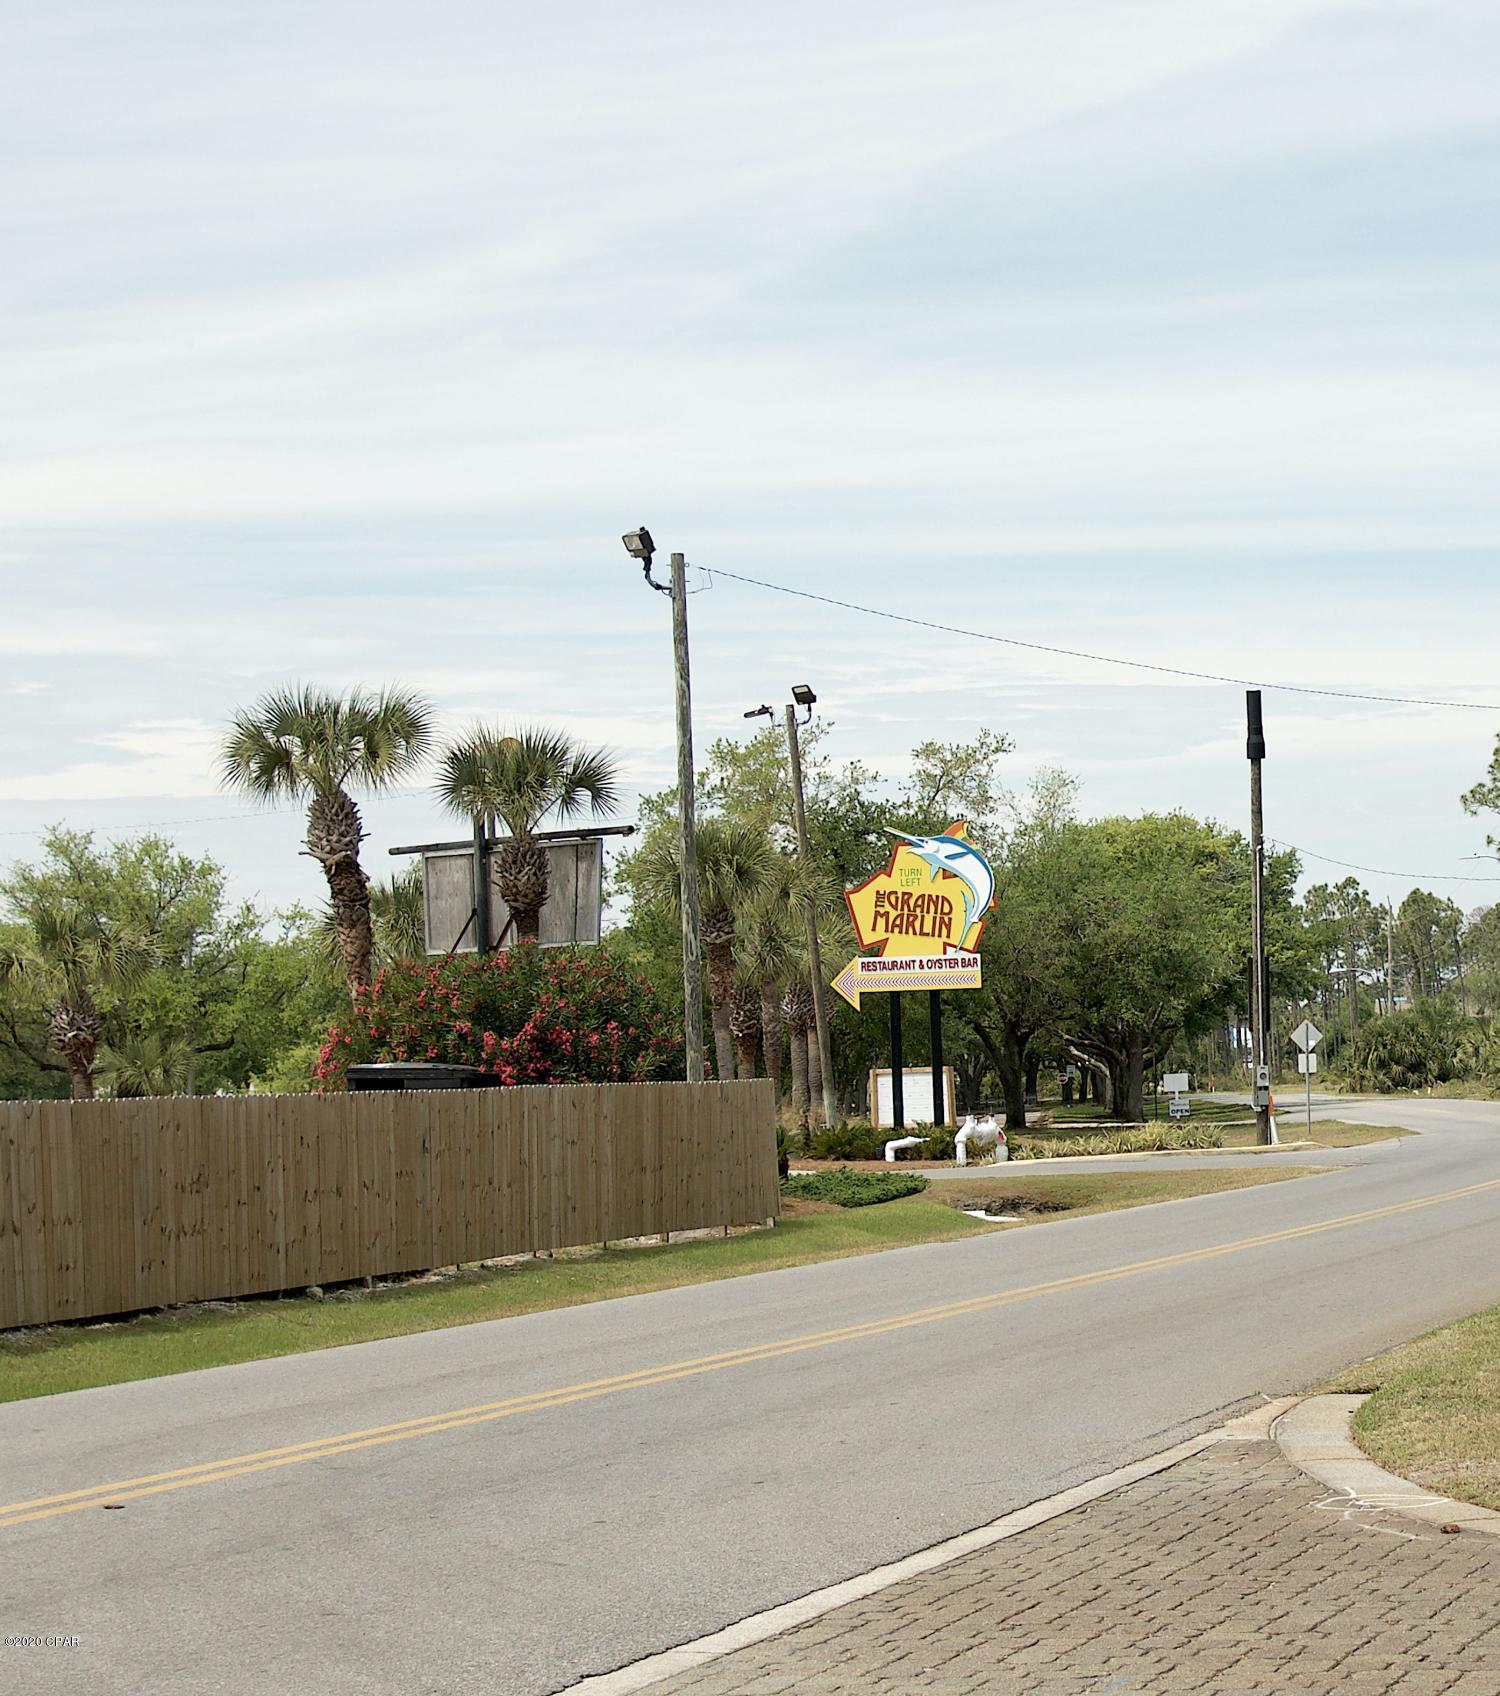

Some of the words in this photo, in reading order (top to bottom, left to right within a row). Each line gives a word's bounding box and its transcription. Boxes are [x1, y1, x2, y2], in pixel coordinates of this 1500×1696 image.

[899, 868, 922, 877] TURN
[900, 878, 920, 887] LEFT
[875, 890, 886, 909] THE
[886, 890, 953, 916] GRAND
[871, 910, 952, 939] MARLIN
[861, 959, 916, 972] RESTAURANT
[919, 960, 925, 970] &
[926, 958, 959, 970] OYSTER
[960, 957, 978, 969] BAR
